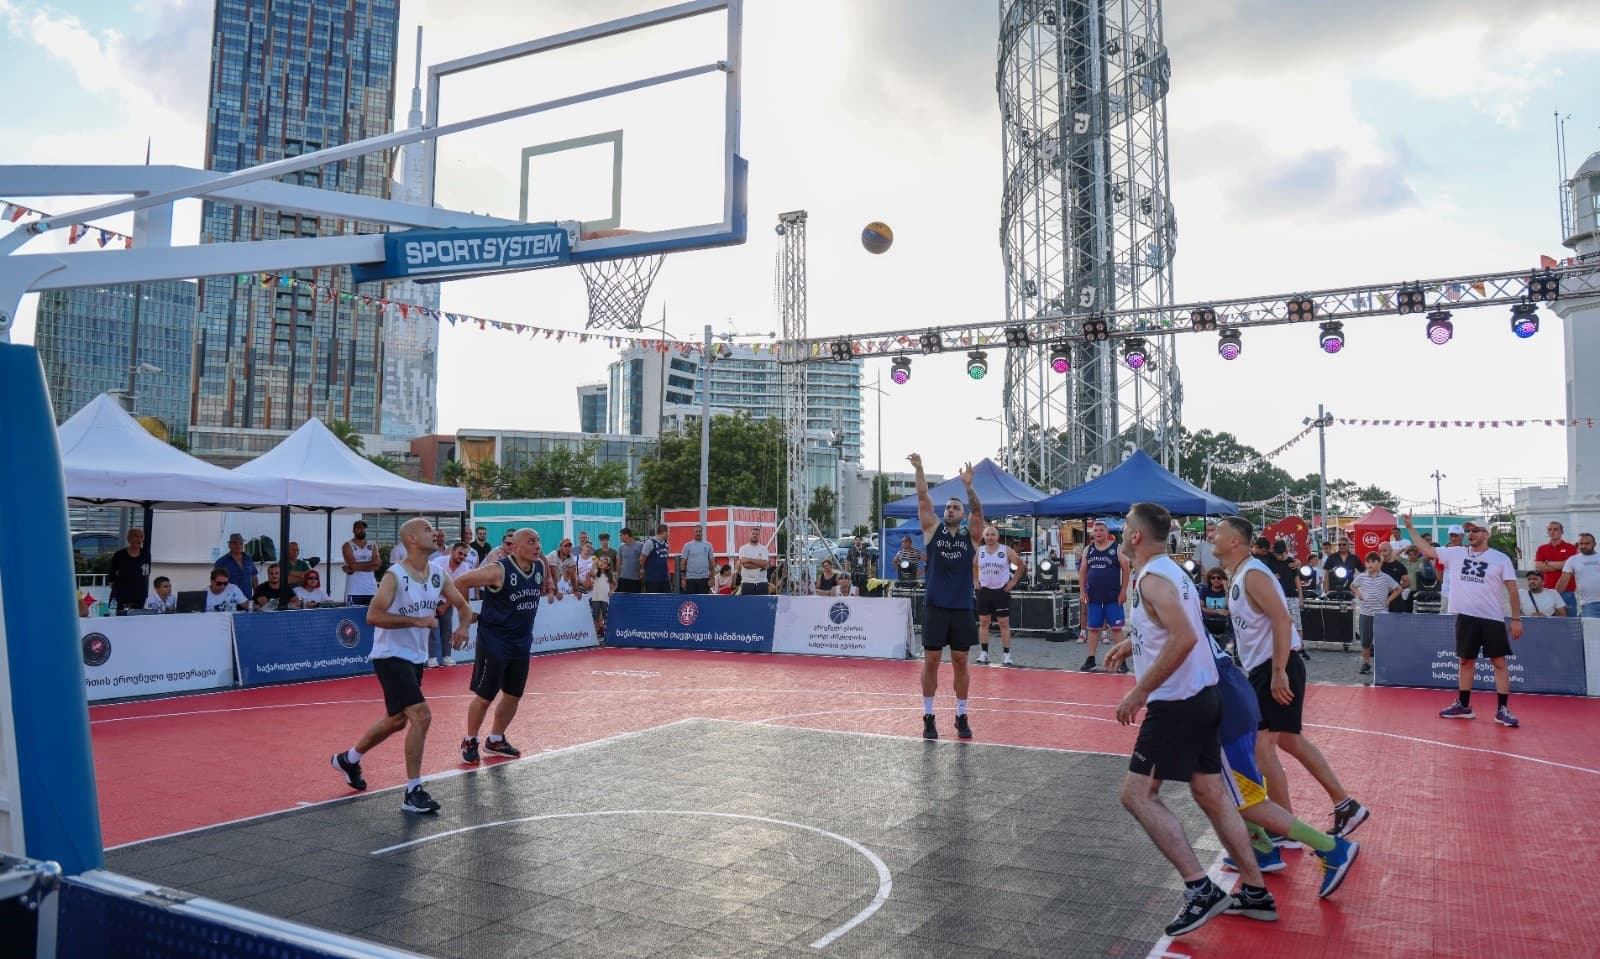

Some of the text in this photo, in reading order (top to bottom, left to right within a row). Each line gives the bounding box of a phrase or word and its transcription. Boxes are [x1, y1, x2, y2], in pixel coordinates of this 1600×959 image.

[510, 573, 518, 586] 8
[615, 628, 669, 640] საქართველოს
[714, 632, 765, 643] სამინისტრო
[256, 660, 312, 673] საქართველოს
[112, 671, 164, 686] ეროვნული
[165, 668, 217, 682] ფედერაცია
